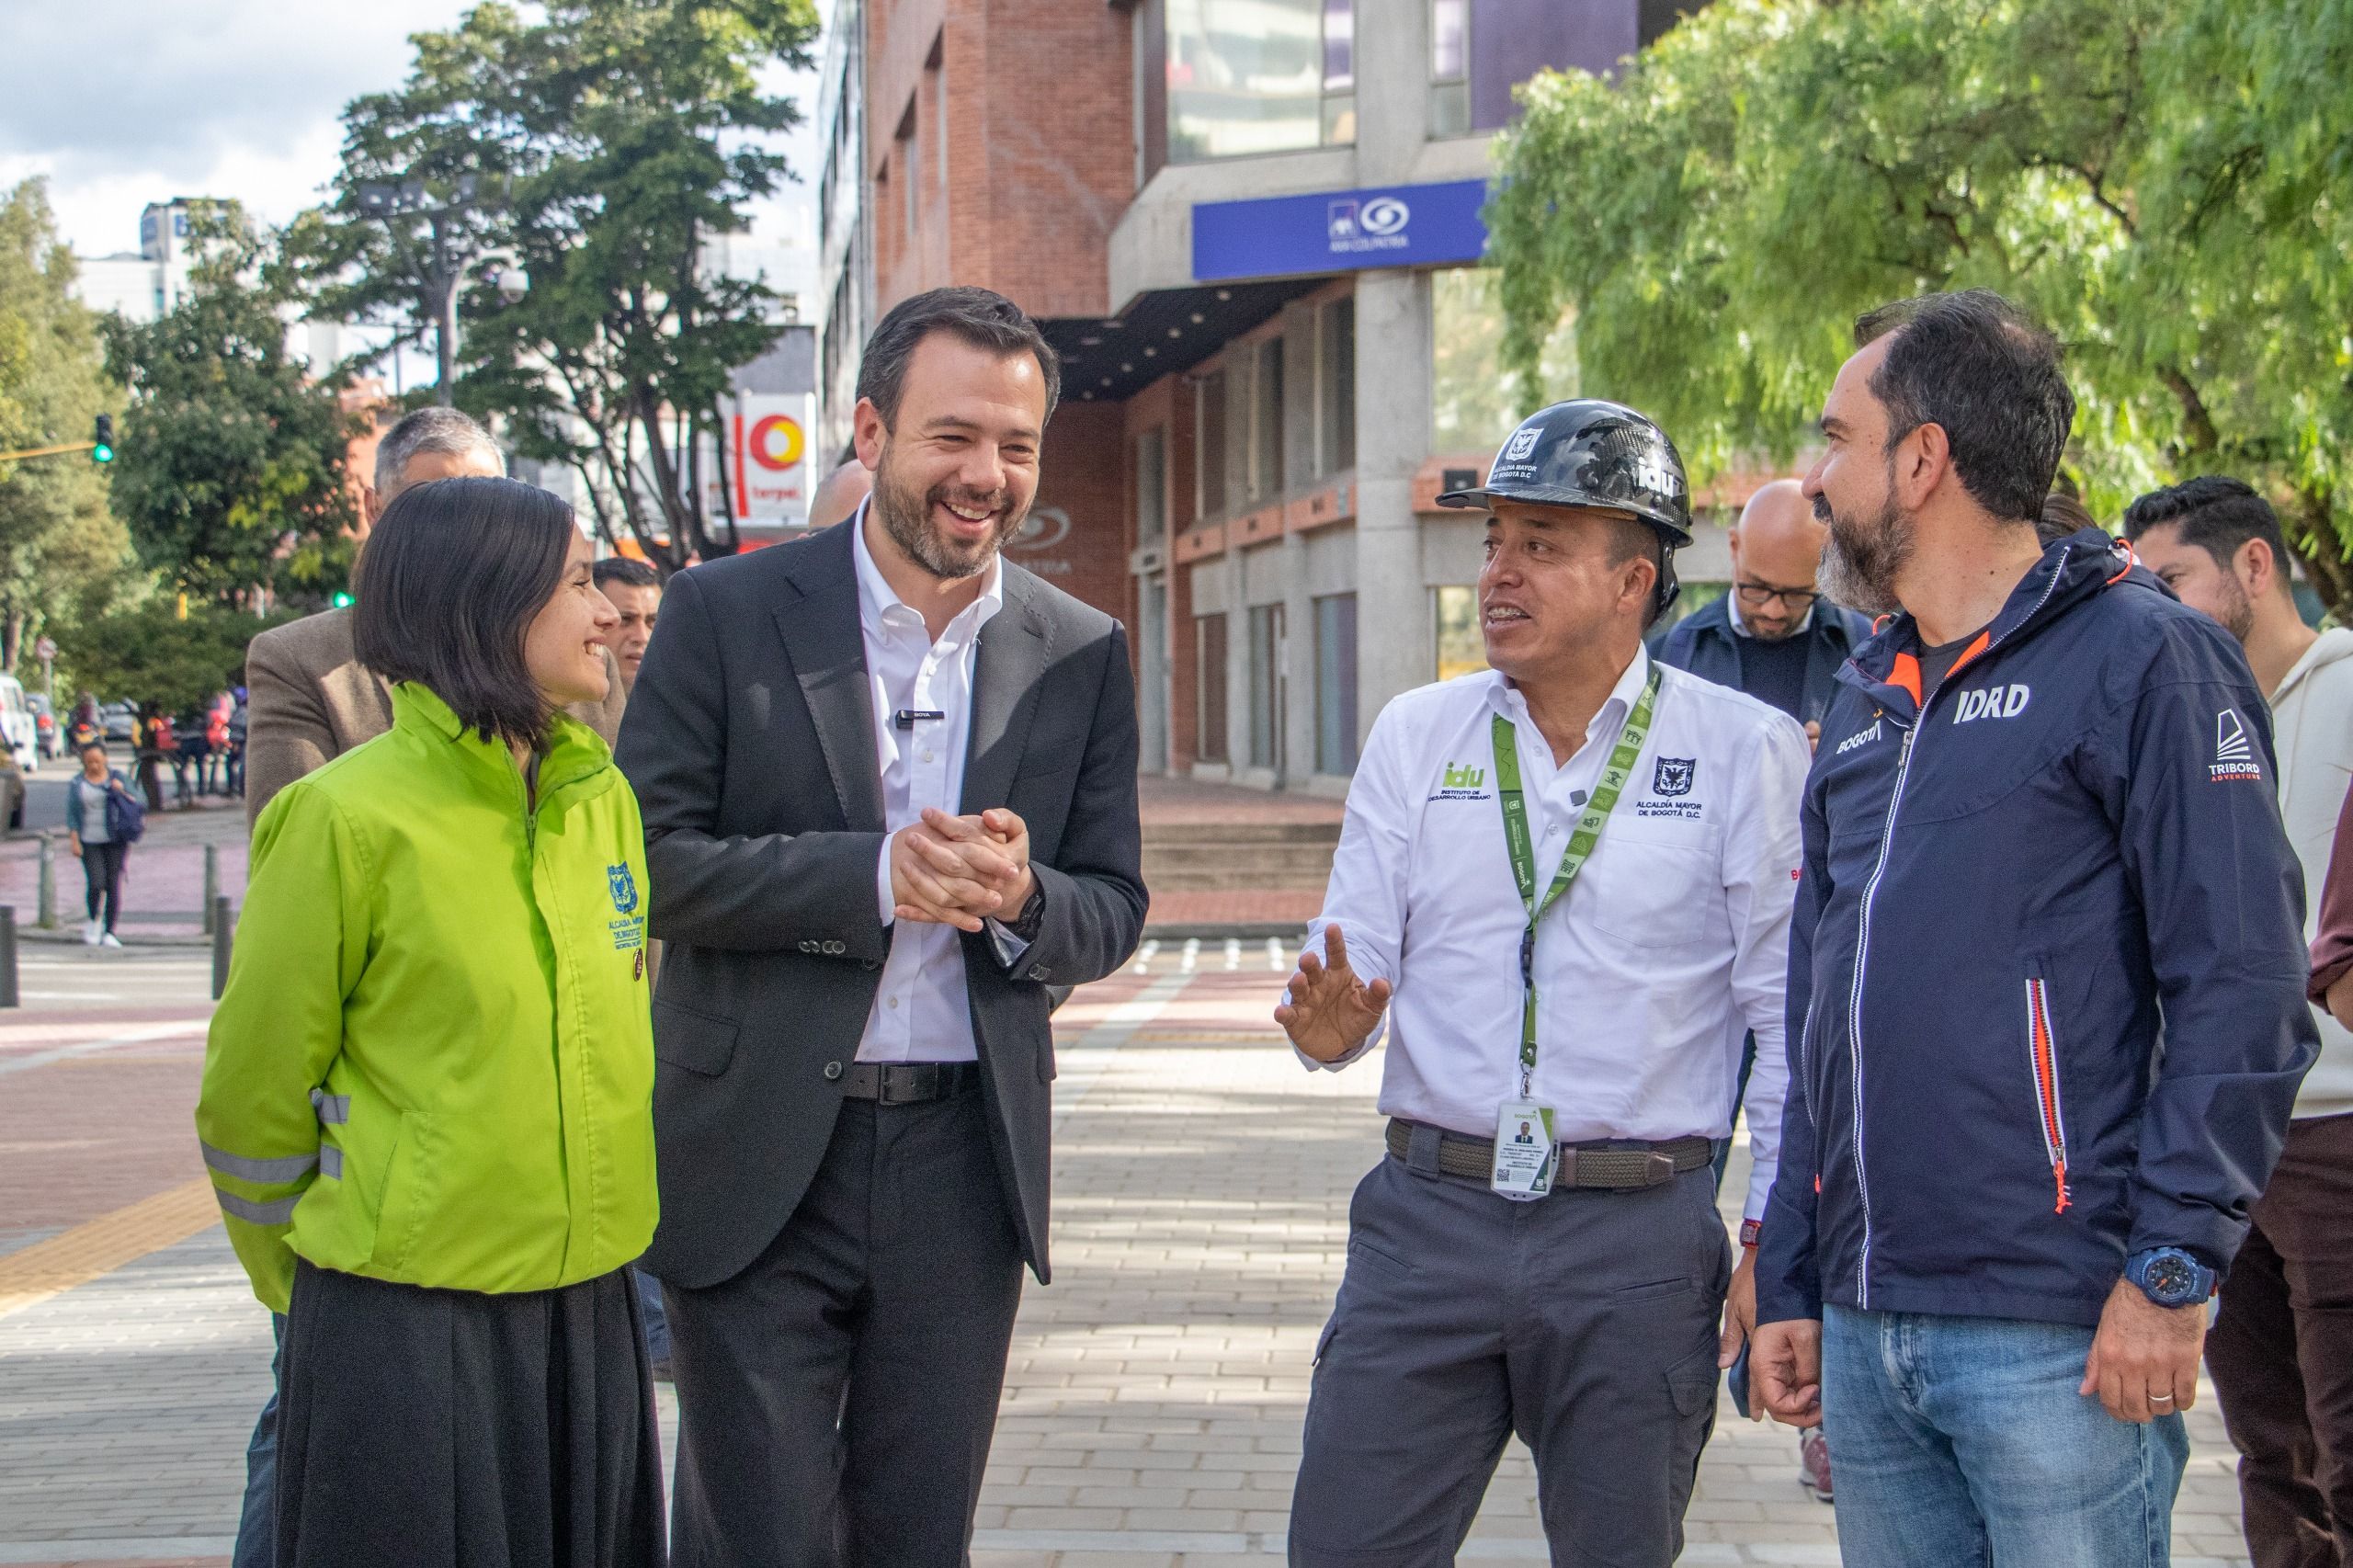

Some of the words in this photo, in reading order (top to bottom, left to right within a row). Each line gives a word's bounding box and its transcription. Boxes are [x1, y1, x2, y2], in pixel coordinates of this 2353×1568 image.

[1953, 684, 2029, 724] IDRD
[1442, 761, 1484, 788] idu
[2209, 763, 2260, 775] TRIBORD
[2211, 773, 2261, 782] ADVENTURE
[1636, 800, 1673, 809] ALCALDÍA
[1675, 801, 1702, 811] MAYOR
[1651, 808, 1683, 817] BOGOTÁ
